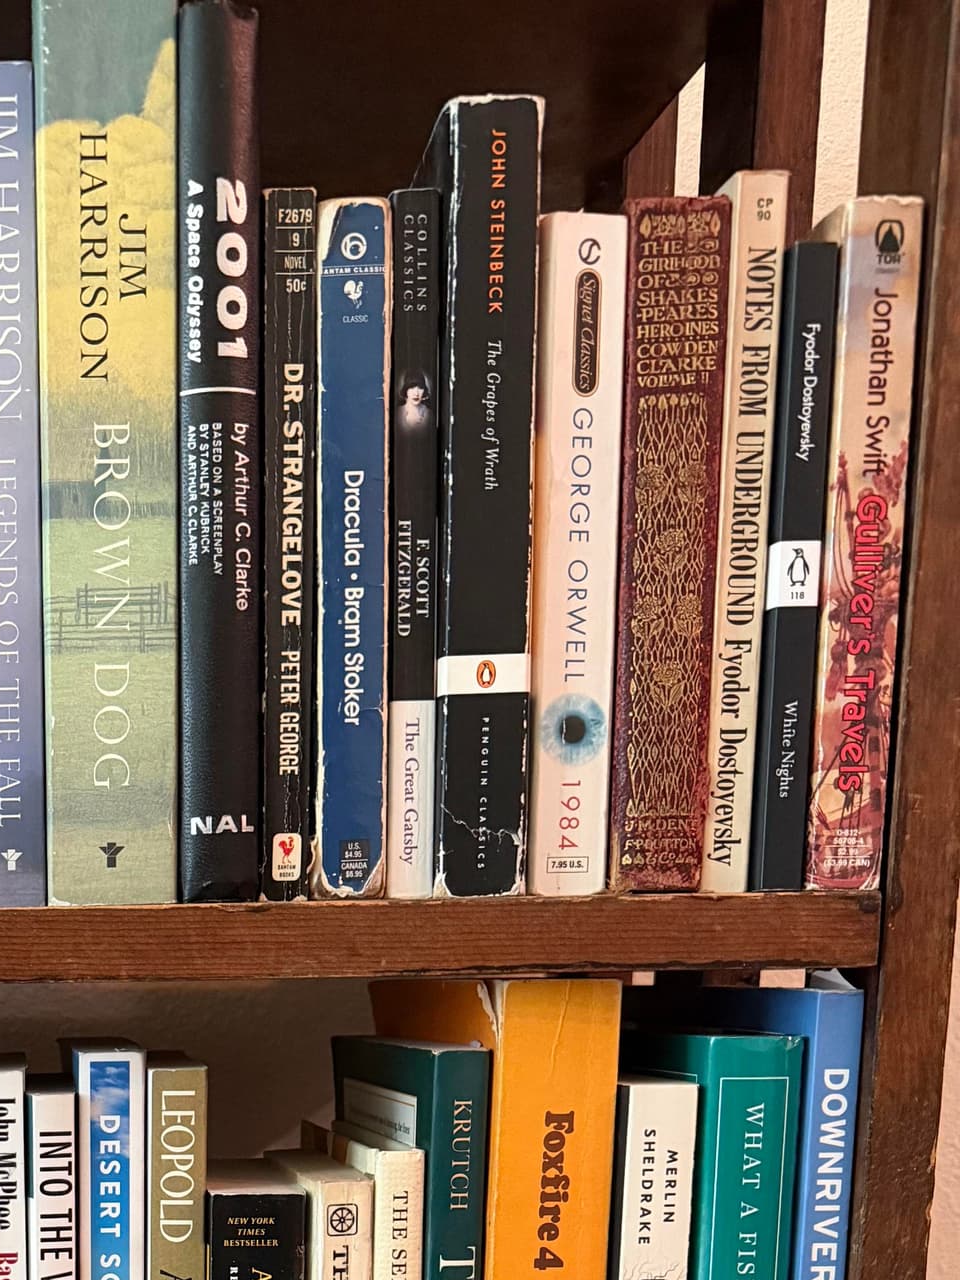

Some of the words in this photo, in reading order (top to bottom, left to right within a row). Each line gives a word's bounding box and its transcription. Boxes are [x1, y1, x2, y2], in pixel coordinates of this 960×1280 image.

[187, 180, 204, 198] A
[490, 129, 507, 189] JOHN
[187, 203, 205, 270] Space
[278, 208, 313, 223] F2679
[216, 177, 249, 360] 2001
[487, 200, 506, 313] STEINBECK
[187, 275, 205, 364] Odyssey
[867, 287, 898, 407] Jonathan
[283, 363, 304, 412] DR.
[862, 415, 890, 478] Swift
[280, 421, 304, 626] STRANGELOVE
[343, 470, 365, 567] Dracula
[343, 587, 365, 648] Bram
[790, 591, 805, 600] 118
[279, 651, 300, 705] PETER
[343, 651, 365, 727] Stoker
[279, 711, 300, 777] GEORGE
[782, 700, 799, 749] White
[775, 750, 795, 799] Nights
[190, 815, 254, 835] NAL
[550, 860, 566, 870] 7.95
[568, 860, 584, 870] U.S.
[39, 1131, 73, 1197] INTO
[99, 1115, 121, 1238] DESERT
[159, 1089, 196, 1244] LEOPOLD
[449, 1099, 473, 1211] KRUTCH
[538, 1110, 576, 1242] Foxfire
[663, 1149, 679, 1223] MERLIN
[391, 1191, 409, 1240] THE
[638, 1128, 657, 1245] SHELDRAKE
[39, 1212, 73, 1261] THE
[223, 1239, 279, 1247] BESTSELLER
[227, 1217, 247, 1225] NEW
[250, 1217, 276, 1225] YORK
[237, 1228, 266, 1236] TIMES
[533, 1245, 564, 1271] 4
